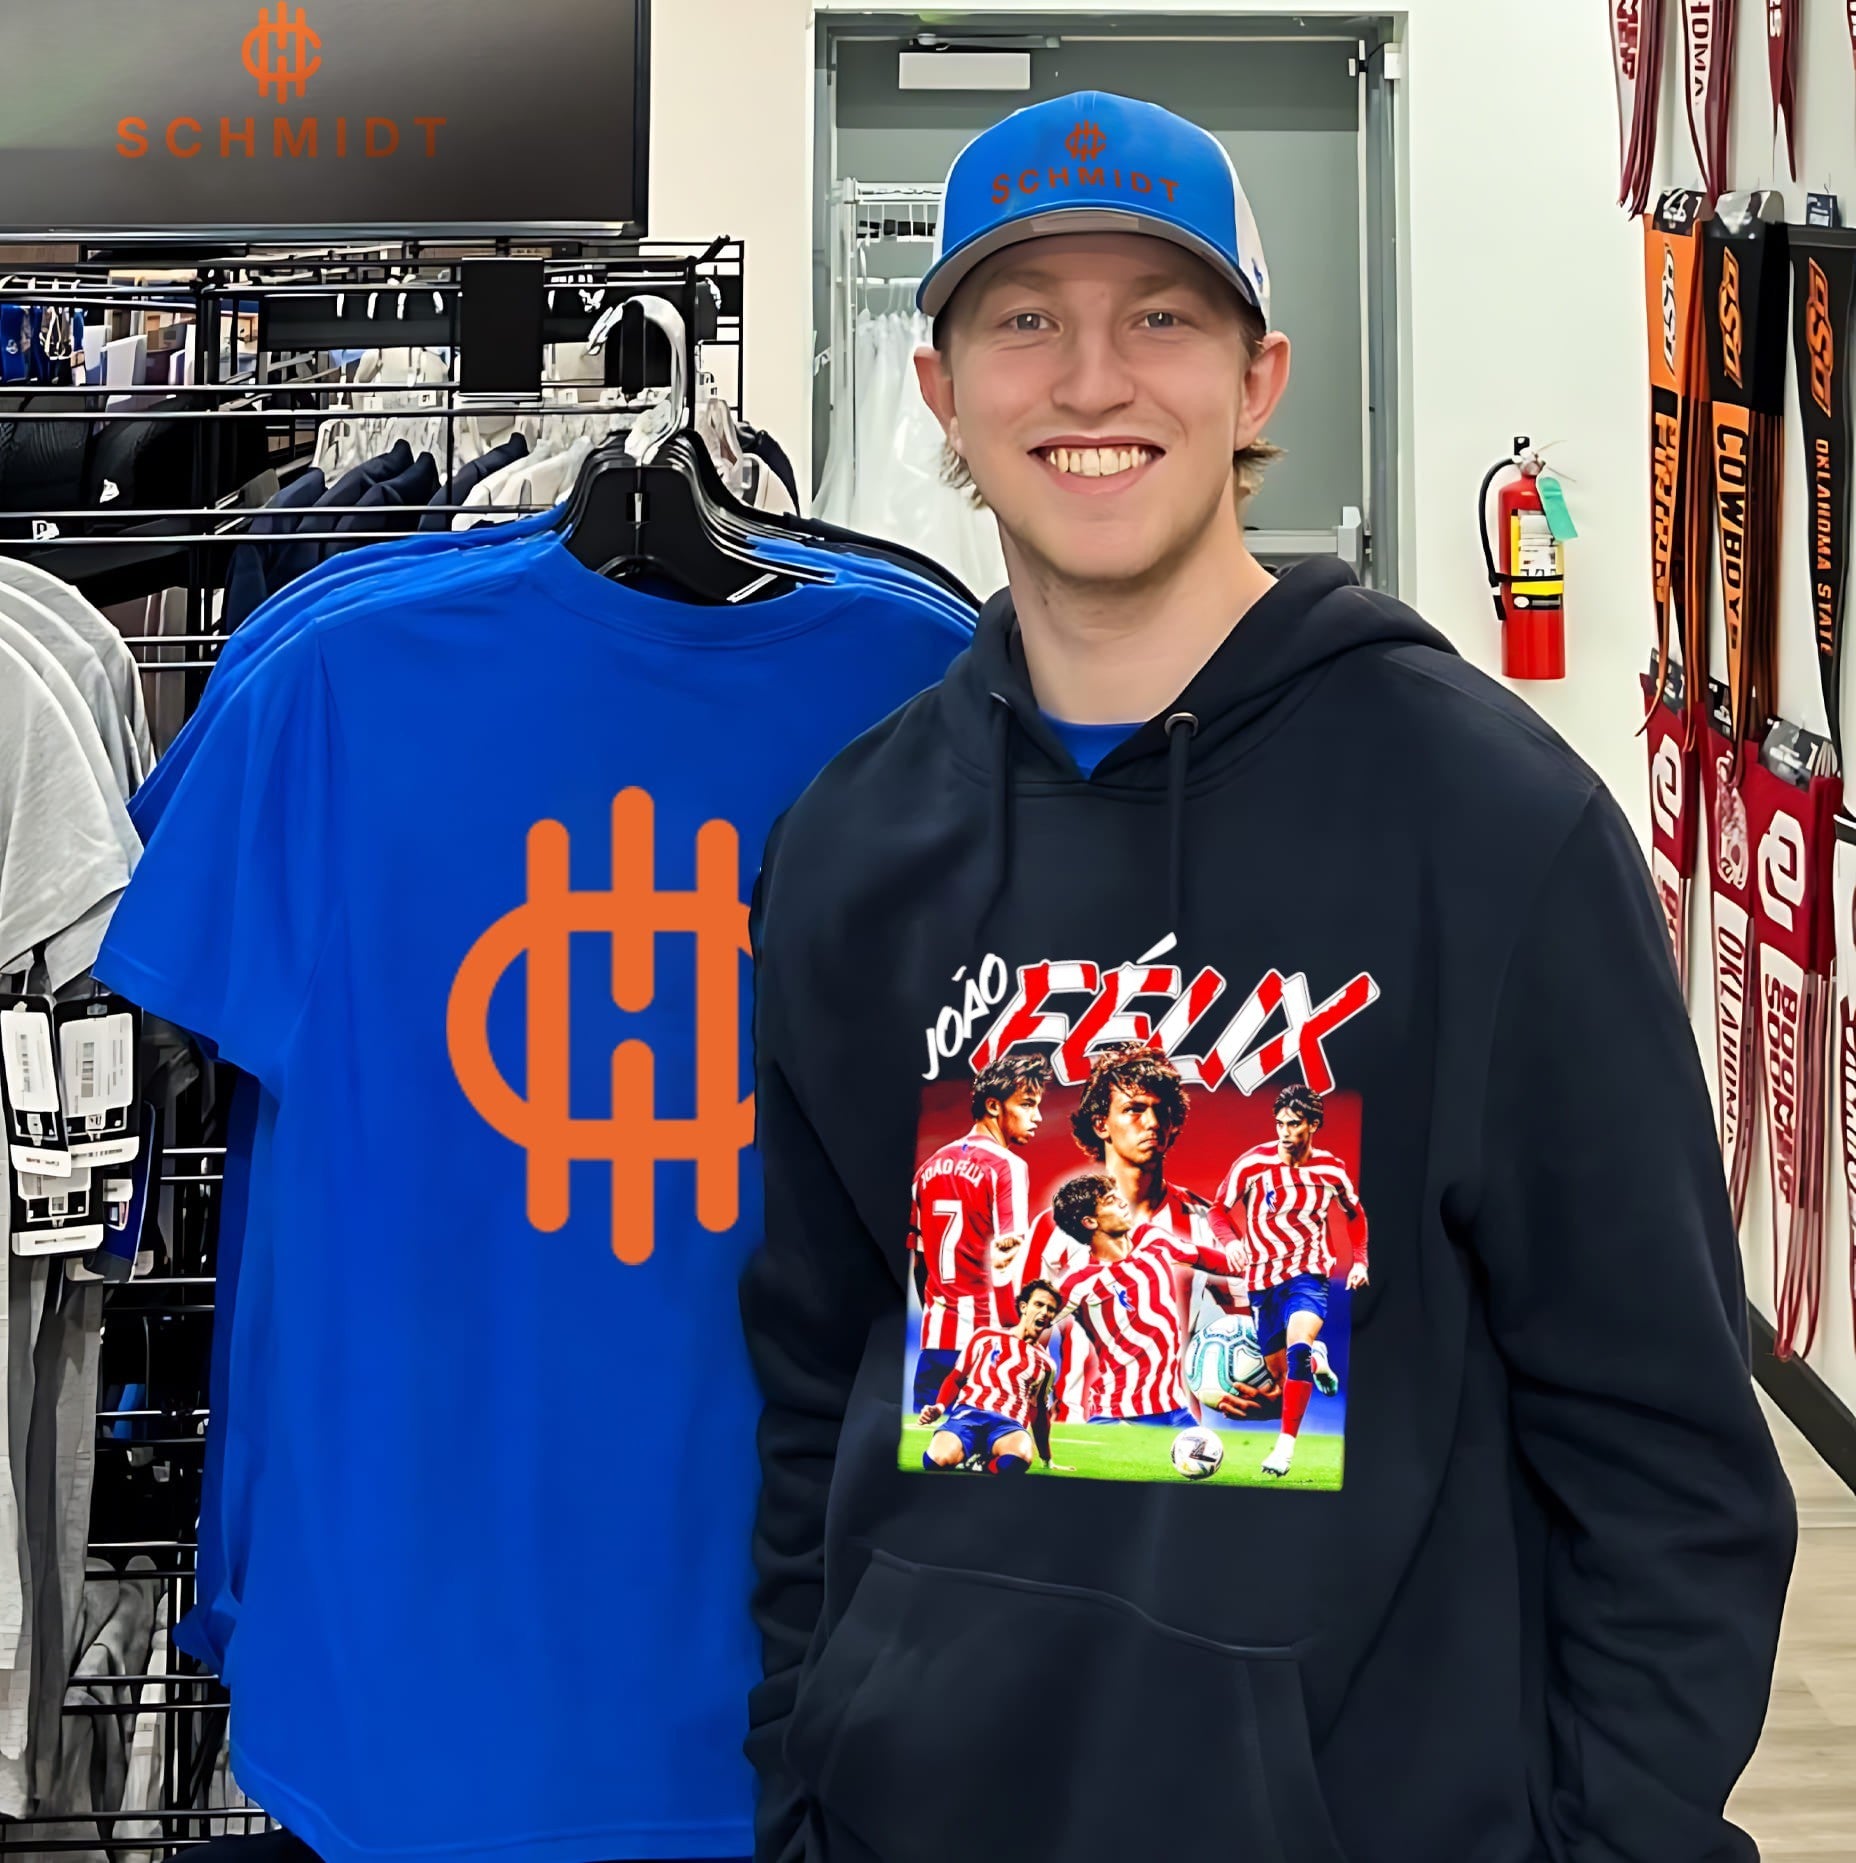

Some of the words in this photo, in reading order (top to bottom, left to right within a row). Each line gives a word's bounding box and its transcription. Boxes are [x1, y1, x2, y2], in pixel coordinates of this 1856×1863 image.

[116, 116, 447, 158] SCHMIDT
[991, 166, 1179, 204] SCHMIDT
[1815, 438, 1832, 571] OKLAHOMA
[1817, 583, 1833, 656] STATE
[969, 932, 1381, 1096] FÉLIX
[1718, 926, 1745, 1144] OKLAHOMA
[932, 1199, 963, 1284] 7
